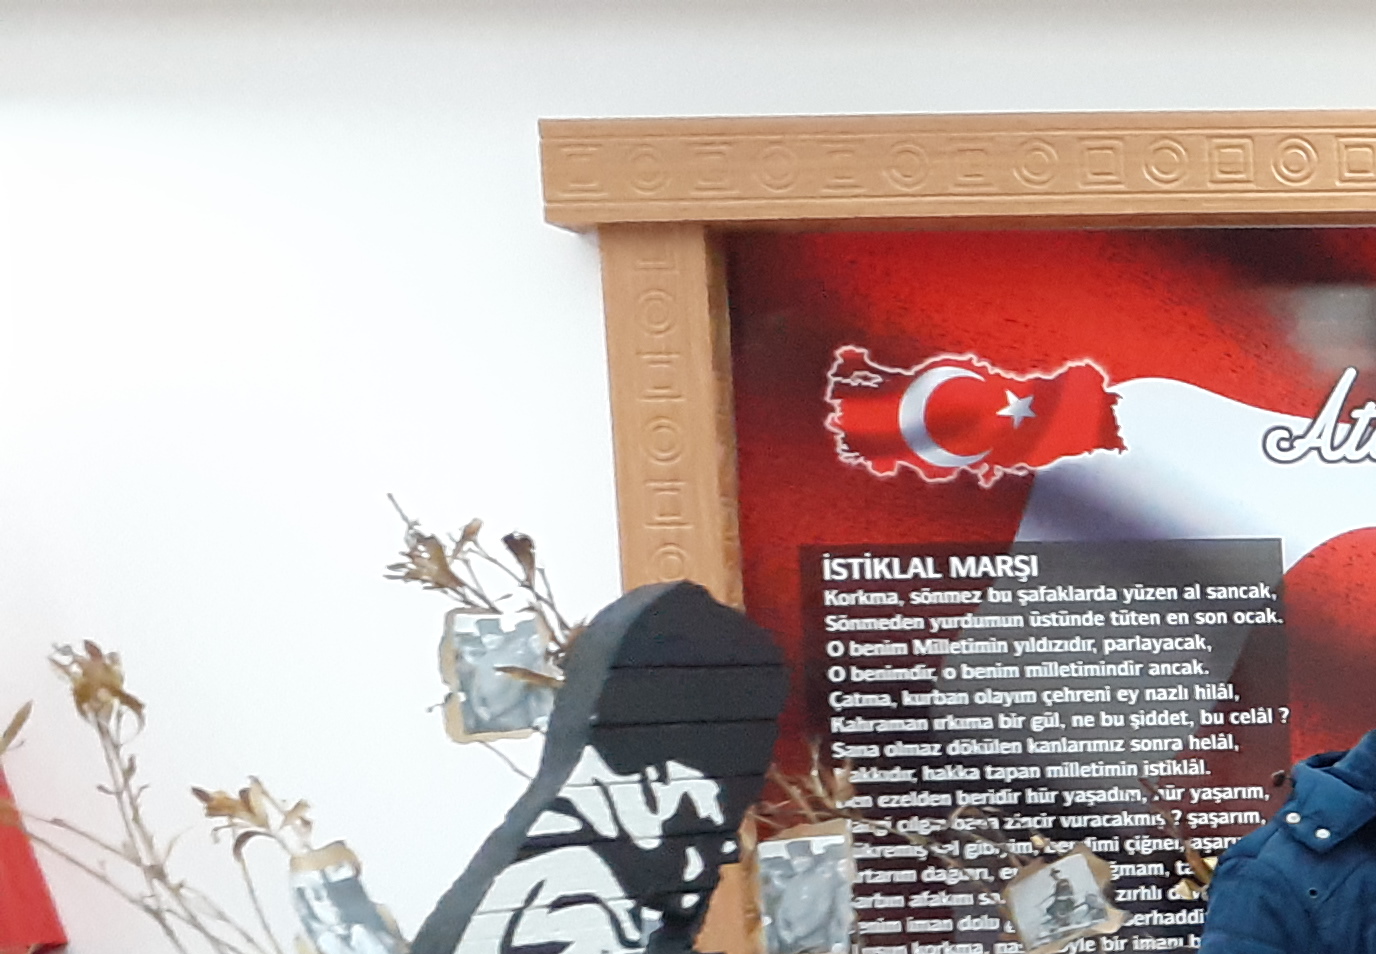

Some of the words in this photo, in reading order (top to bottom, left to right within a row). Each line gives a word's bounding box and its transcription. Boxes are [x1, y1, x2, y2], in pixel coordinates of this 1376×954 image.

[822, 551, 943, 581] İSTİKLAL
[949, 554, 1039, 583] MARŞI
[823, 588, 904, 606] Korkma,
[908, 587, 982, 604] sönmez
[986, 586, 1012, 603] bu
[1015, 583, 1117, 607] şafaklarda
[1121, 583, 1177, 604] yüzen
[1182, 582, 1200, 599] al
[1205, 581, 1276, 600] sancak,
[824, 613, 924, 631] Sönmeden
[928, 611, 1024, 633] yurdumun
[1027, 609, 1105, 628] üstünde
[1108, 608, 1160, 626] tüten
[1164, 612, 1189, 625] en
[1193, 610, 1227, 625] son
[1232, 607, 1283, 624] ocak.
[826, 639, 845, 657] O
[849, 638, 908, 657] benim
[912, 636, 1009, 655] Milletimin
[1012, 634, 1098, 657] yıldızıdır,
[1102, 633, 1212, 655] parlayacak,
[828, 664, 846, 682] O
[850, 663, 938, 681] benimdir,
[942, 666, 957, 679] o
[960, 662, 1020, 679] benim
[1023, 659, 1144, 678] milletimindir
[1148, 657, 1210, 676] ancak.
[828, 690, 897, 710] Çatma,
[900, 688, 969, 705] kurban
[972, 687, 1037, 707] olayım
[1039, 684, 1111, 706] çehreni
[1114, 687, 1139, 705] ey
[1143, 683, 1189, 701] nazlı
[1192, 682, 1239, 702] hilâl,
[997, 711, 1026, 729] bir
[1029, 710, 1066, 732] gül,
[1070, 713, 1095, 728] ne
[1098, 710, 1125, 727] bu
[1127, 708, 1194, 731] şiddet,
[1198, 707, 1224, 725] bu
[1228, 706, 1272, 724] celâl
